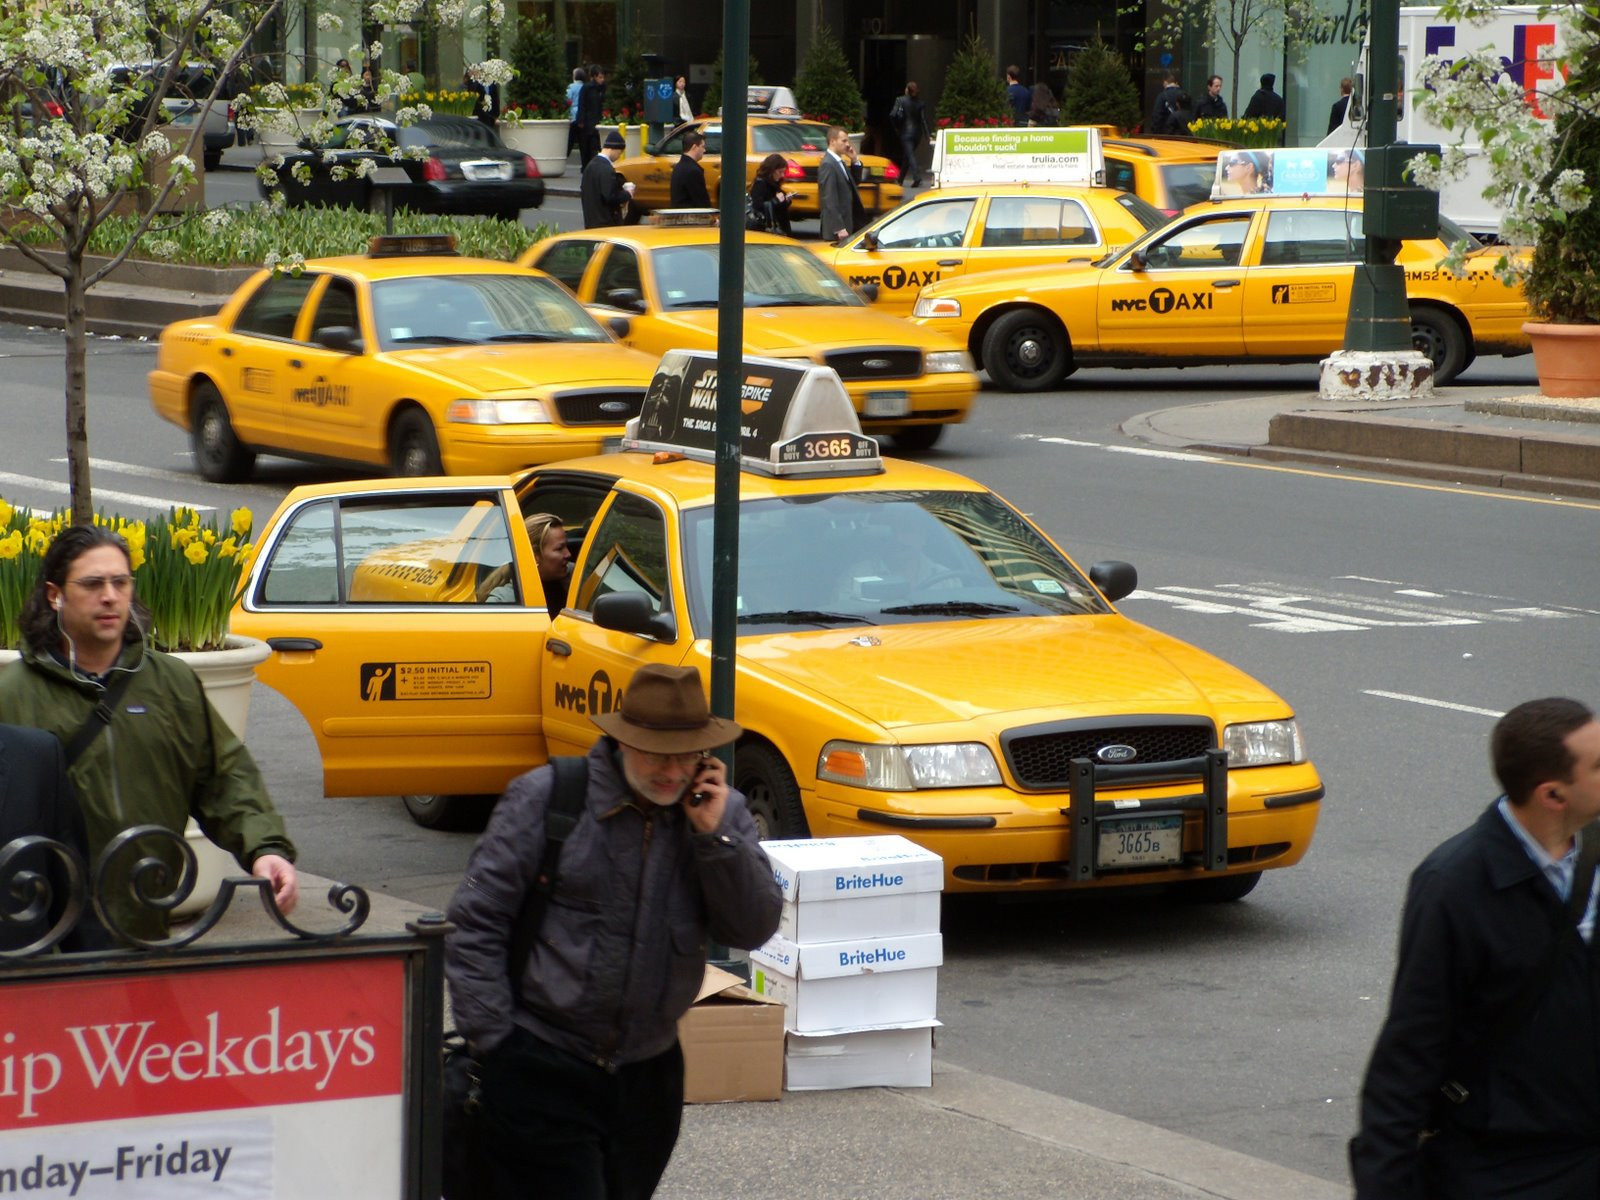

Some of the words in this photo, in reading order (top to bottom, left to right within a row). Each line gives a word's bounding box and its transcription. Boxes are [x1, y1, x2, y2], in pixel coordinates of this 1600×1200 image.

[953, 135, 990, 143] Because
[992, 135, 1020, 144] finding
[1030, 134, 1054, 142] home
[953, 144, 992, 152] shouldn't
[1031, 155, 1079, 163] trulia.com
[882, 265, 940, 290] TAXI
[1112, 299, 1147, 311] NYC
[1149, 288, 1213, 314] TAXI
[741, 384, 772, 401] SPIKE
[683, 417, 695, 429] THE
[694, 419, 712, 432] SAGA
[752, 428, 759, 438] 4
[785, 444, 797, 452] OFF
[804, 439, 851, 458] 3G65
[855, 448, 872, 457] DUTY
[857, 441, 868, 449] OFF
[783, 452, 800, 460] DUTY
[555, 682, 586, 715] NYC
[588, 669, 623, 715] TA
[835, 873, 904, 891] BriteHue
[839, 948, 906, 967] BriteHue
[65, 1006, 375, 1091] Weekdays
